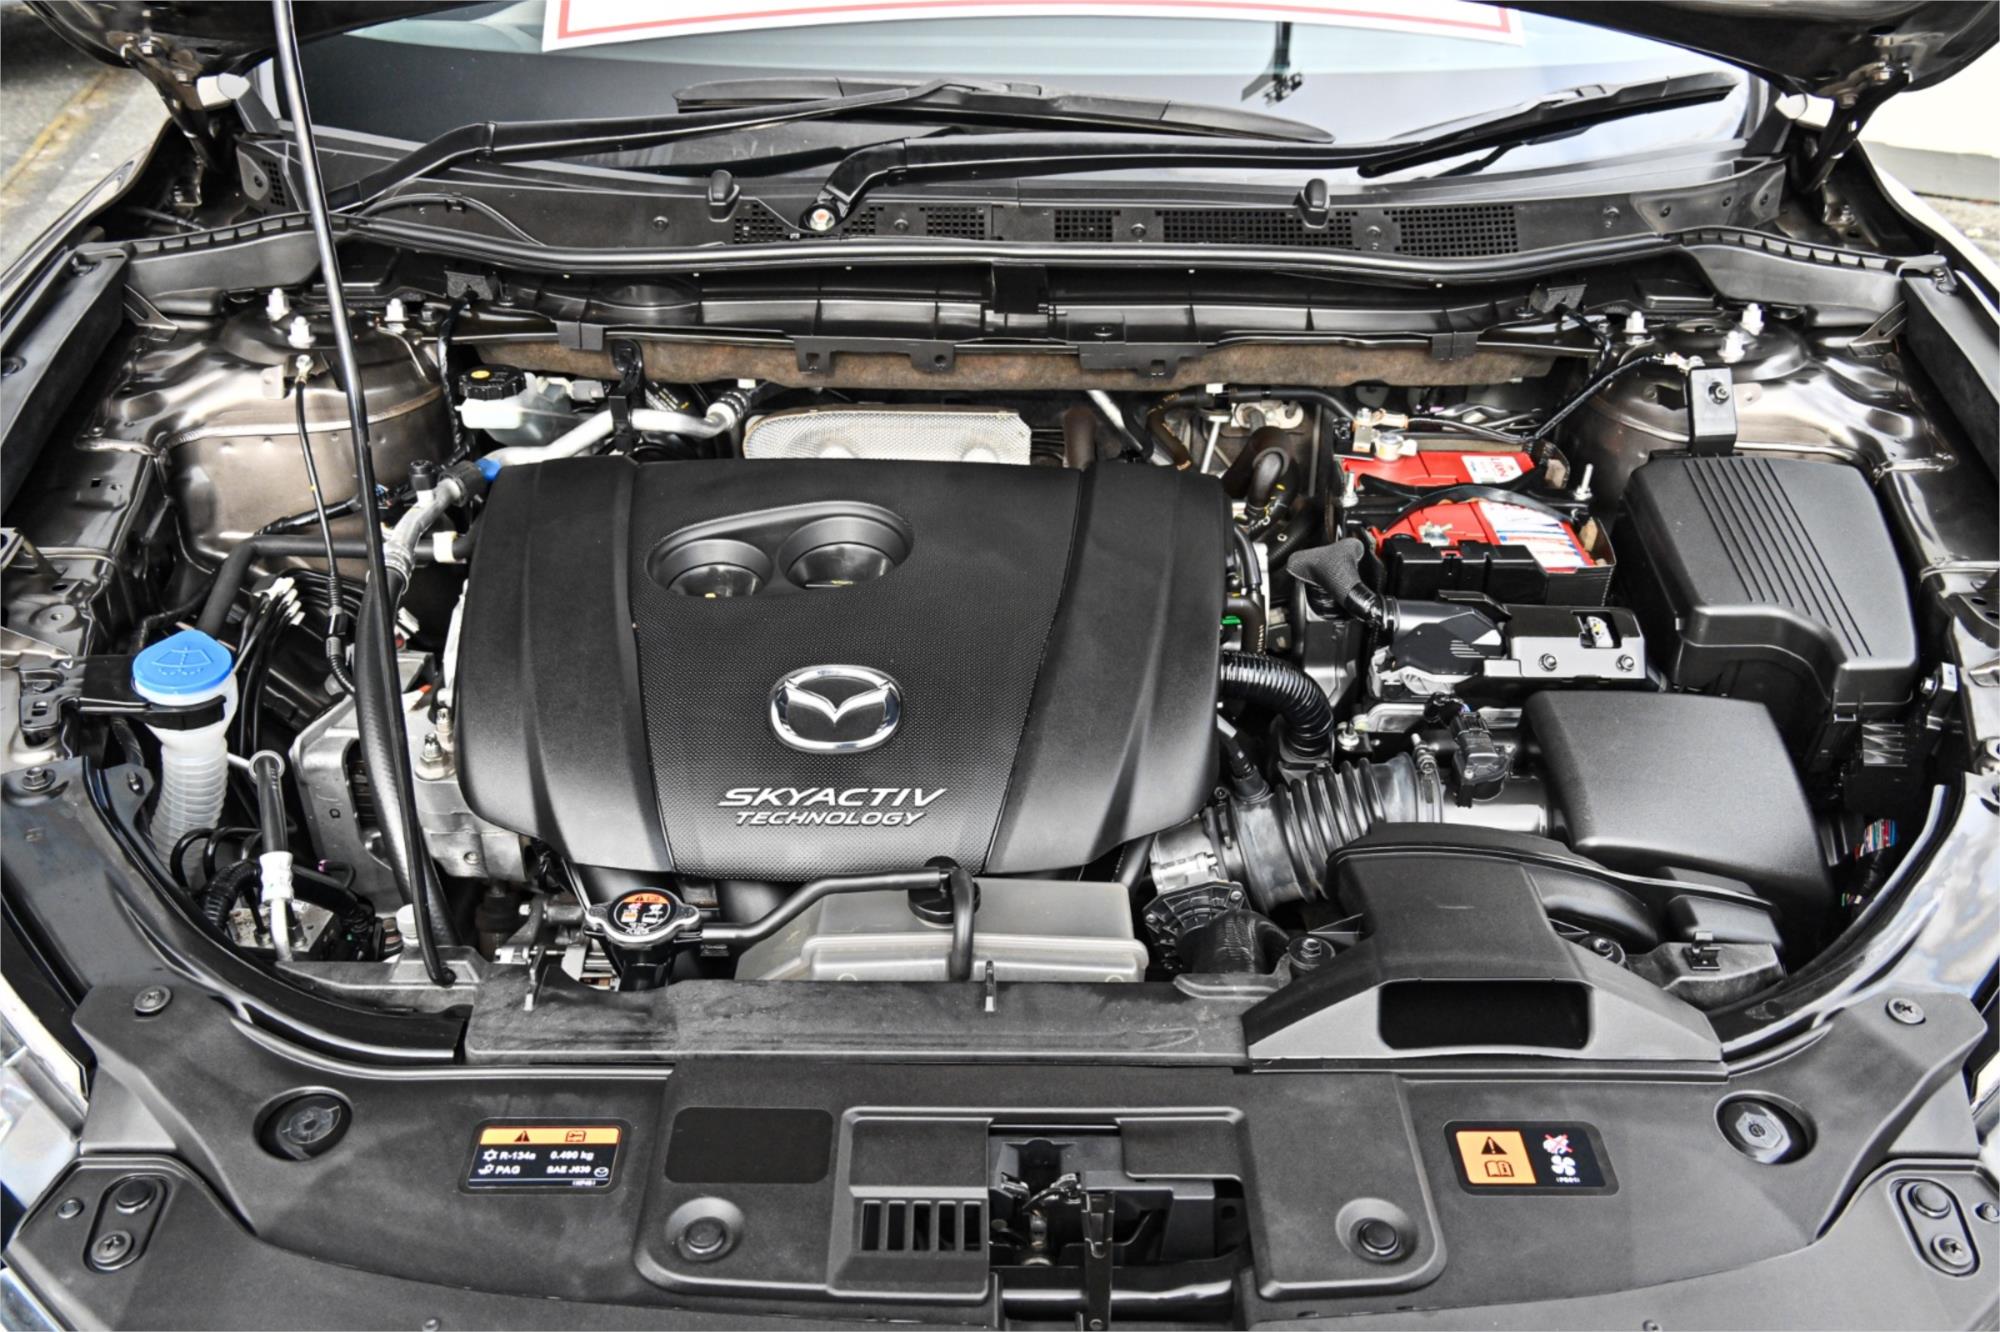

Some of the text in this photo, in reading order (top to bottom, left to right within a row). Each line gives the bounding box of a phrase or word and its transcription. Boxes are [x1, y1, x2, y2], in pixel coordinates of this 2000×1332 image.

[717, 787, 948, 807] SKYACTIV
[736, 811, 927, 826] TECHNOLOGY
[499, 1151, 536, 1160] R-134a
[495, 1165, 521, 1174] PAG
